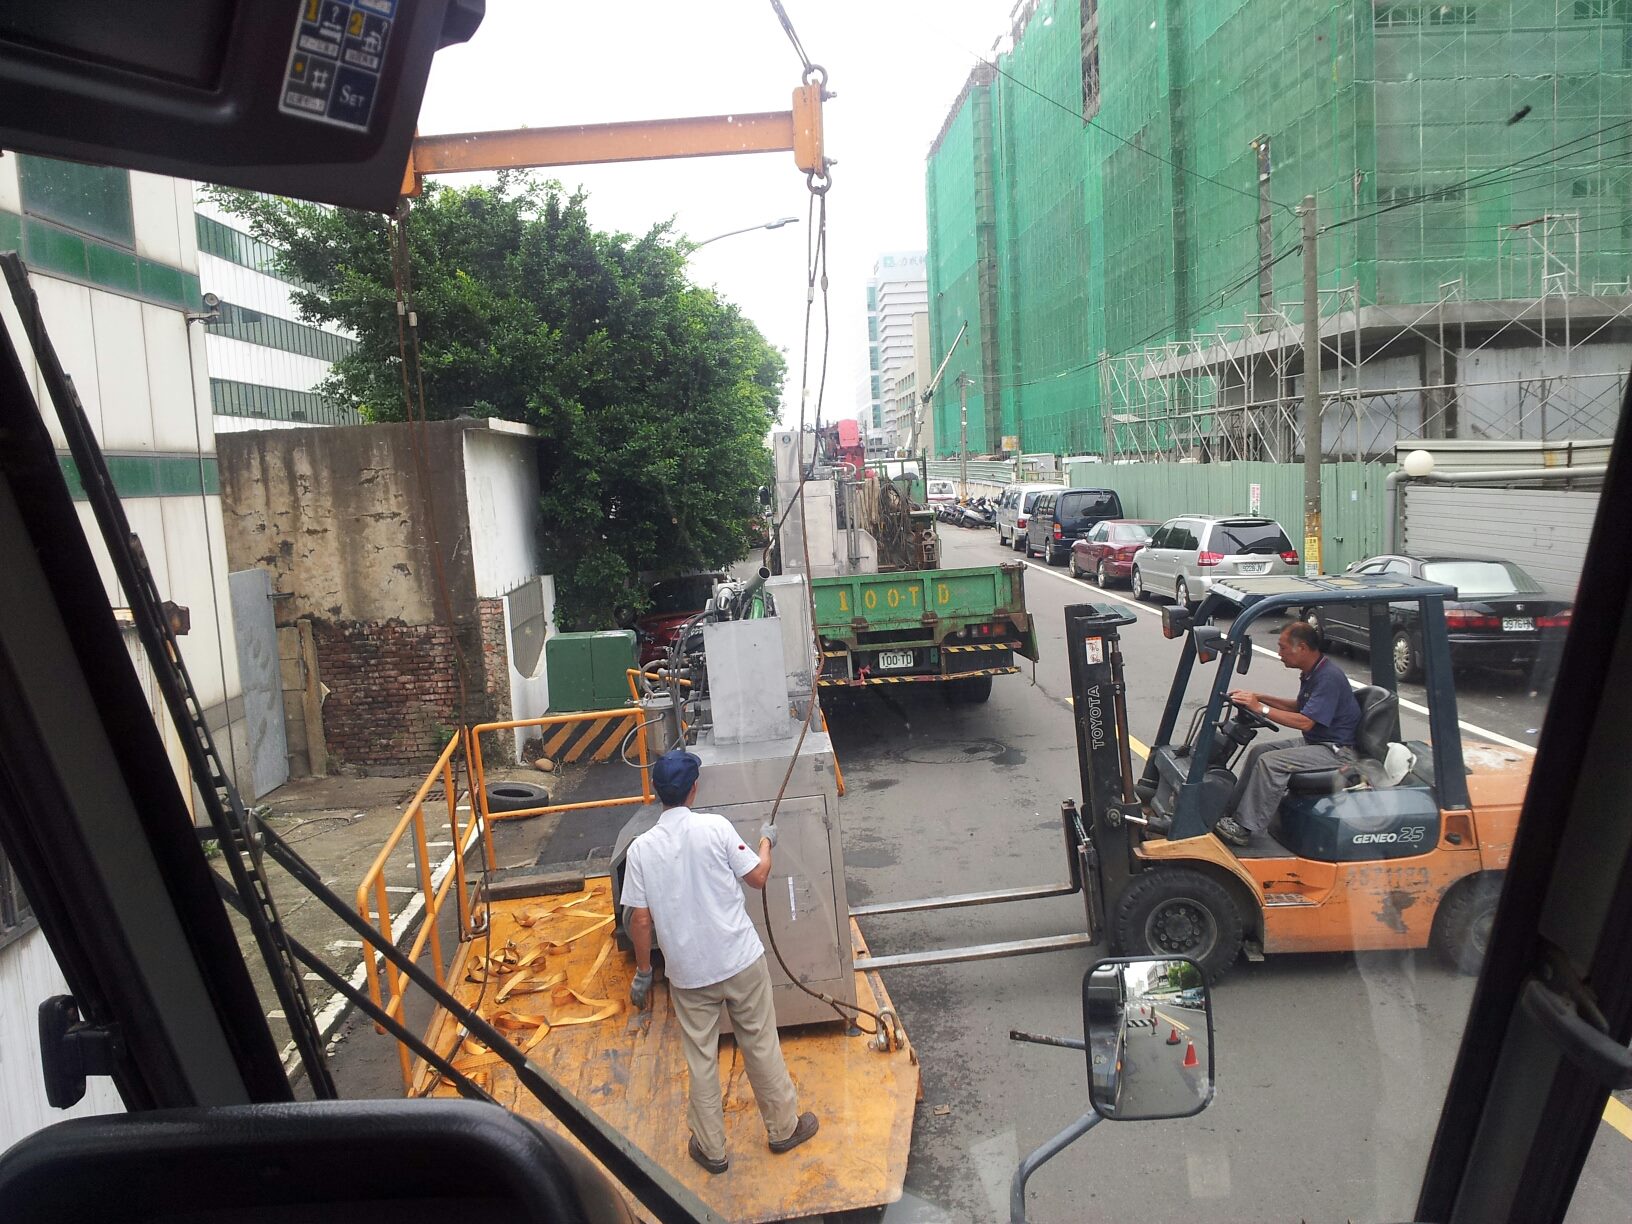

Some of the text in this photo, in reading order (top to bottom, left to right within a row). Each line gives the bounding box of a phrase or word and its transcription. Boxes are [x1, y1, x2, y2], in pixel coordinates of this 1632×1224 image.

[348, 12, 363, 35] 2
[1088, 684, 1105, 750] TOYOTA
[1353, 826, 1426, 844] GENEO 25
